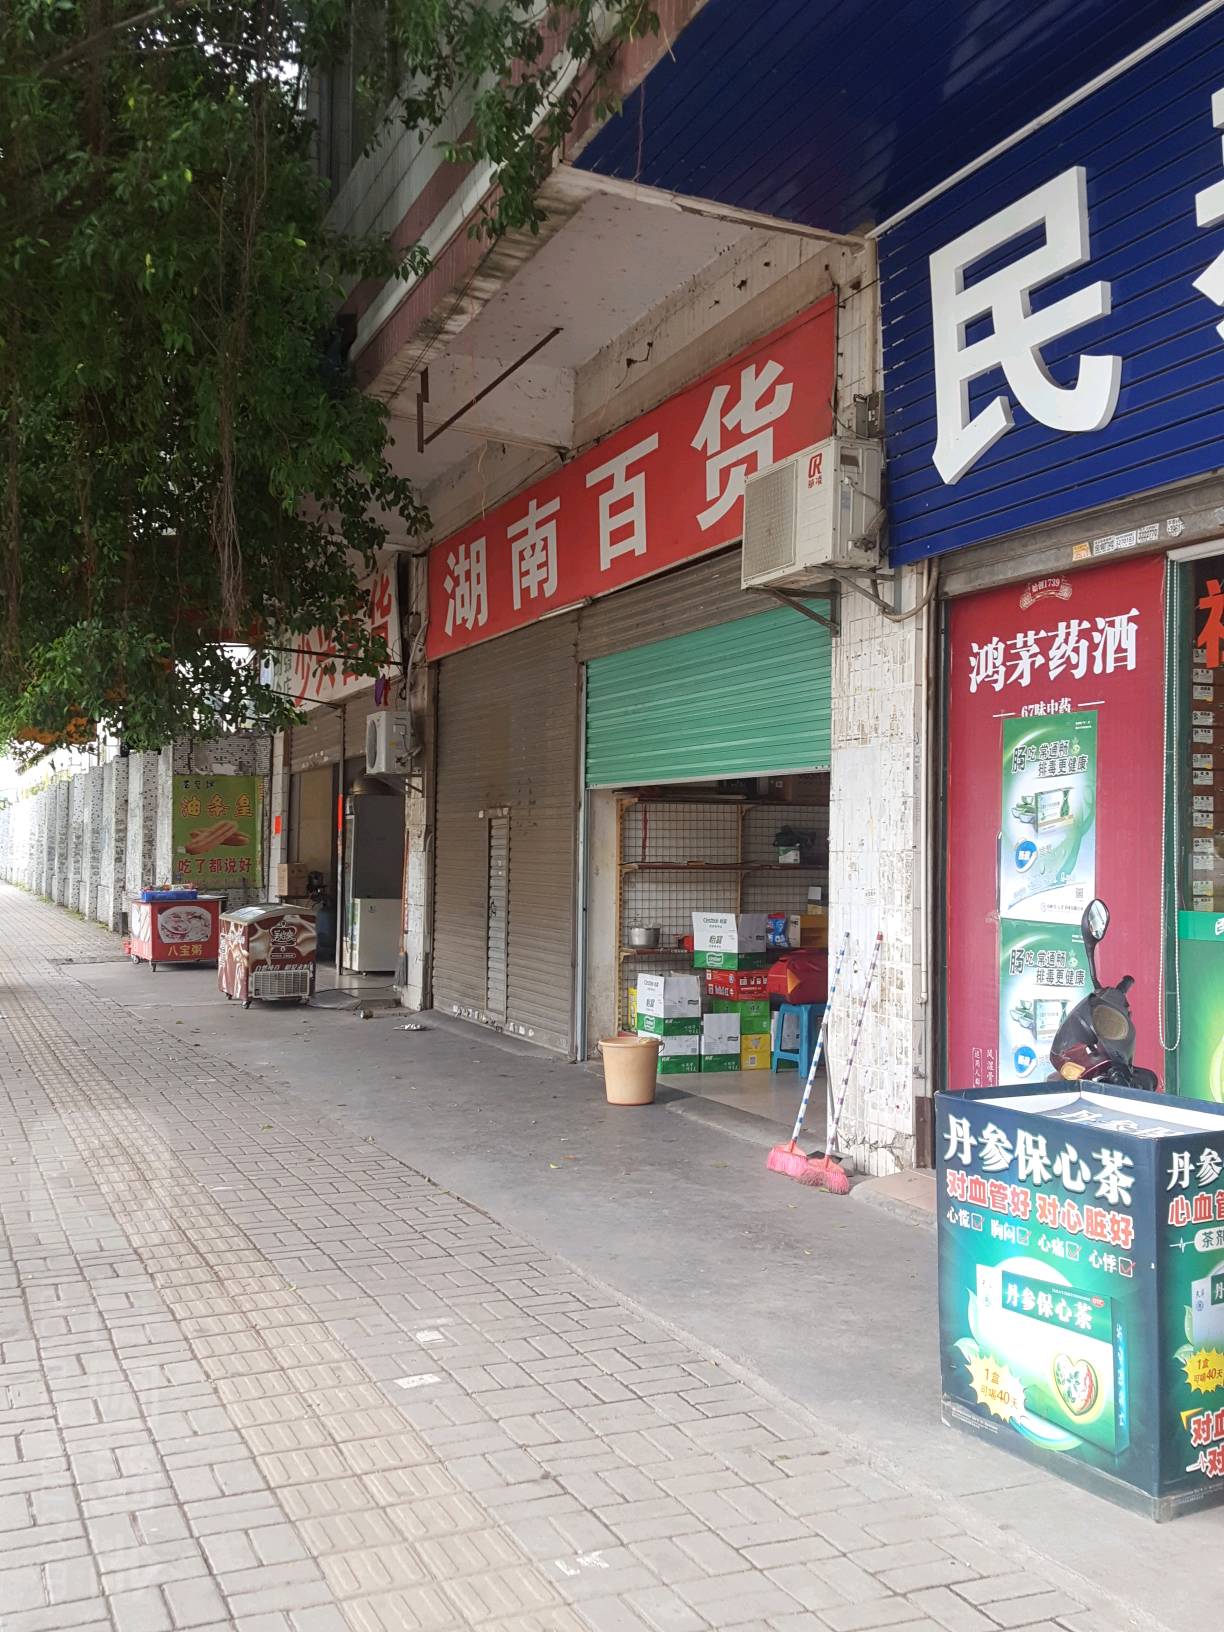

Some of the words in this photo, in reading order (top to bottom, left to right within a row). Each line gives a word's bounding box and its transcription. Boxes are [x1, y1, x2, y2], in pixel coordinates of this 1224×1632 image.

[444, 358, 794, 638] 湖南百货
[968, 607, 1140, 694] 鸿茅药酒
[178, 857, 253, 875] 吃了都说好
[167, 944, 204, 958] 八宝粥
[986, 1049, 995, 1088] 风湿骨
[943, 1113, 1136, 1207] 丹参保心茶
[946, 1168, 1032, 1222] 对血管好
[1035, 1192, 1136, 1250] 对心脏好
[1006, 1282, 1094, 1331] 丹参保心茶
[984, 1368, 1001, 1386] 1盒
